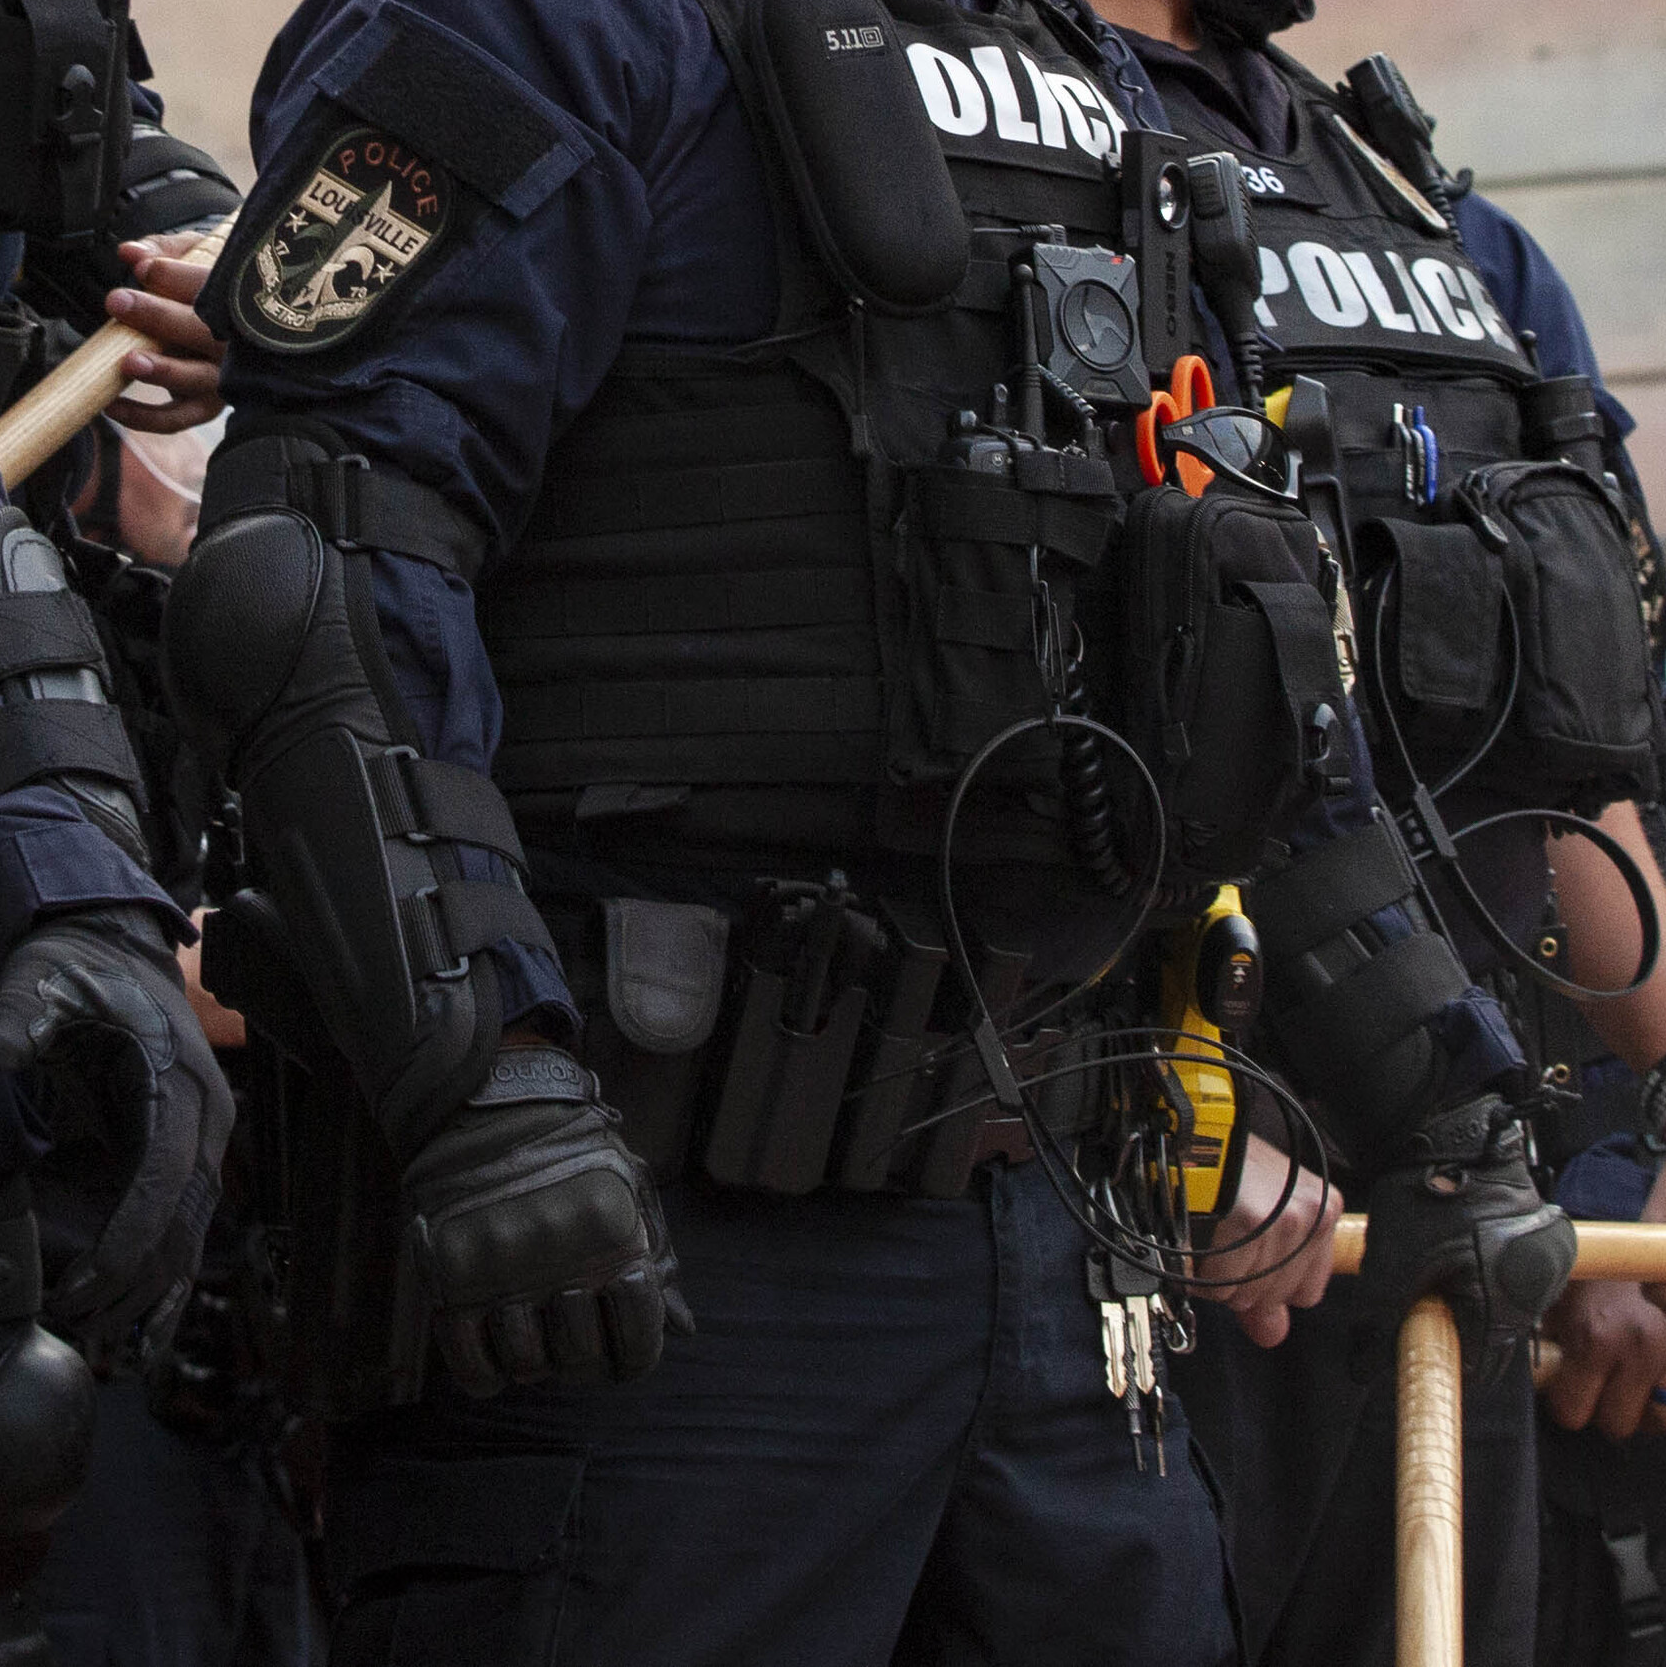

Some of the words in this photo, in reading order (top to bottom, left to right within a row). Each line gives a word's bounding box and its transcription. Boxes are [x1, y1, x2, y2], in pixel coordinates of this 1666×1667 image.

[825, 27, 862, 51] 5.11
[906, 42, 1128, 169] OLIC
[338, 141, 438, 217] POLICE
[1241, 165, 1285, 194] 36
[308, 180, 420, 257] LOUISVILLE
